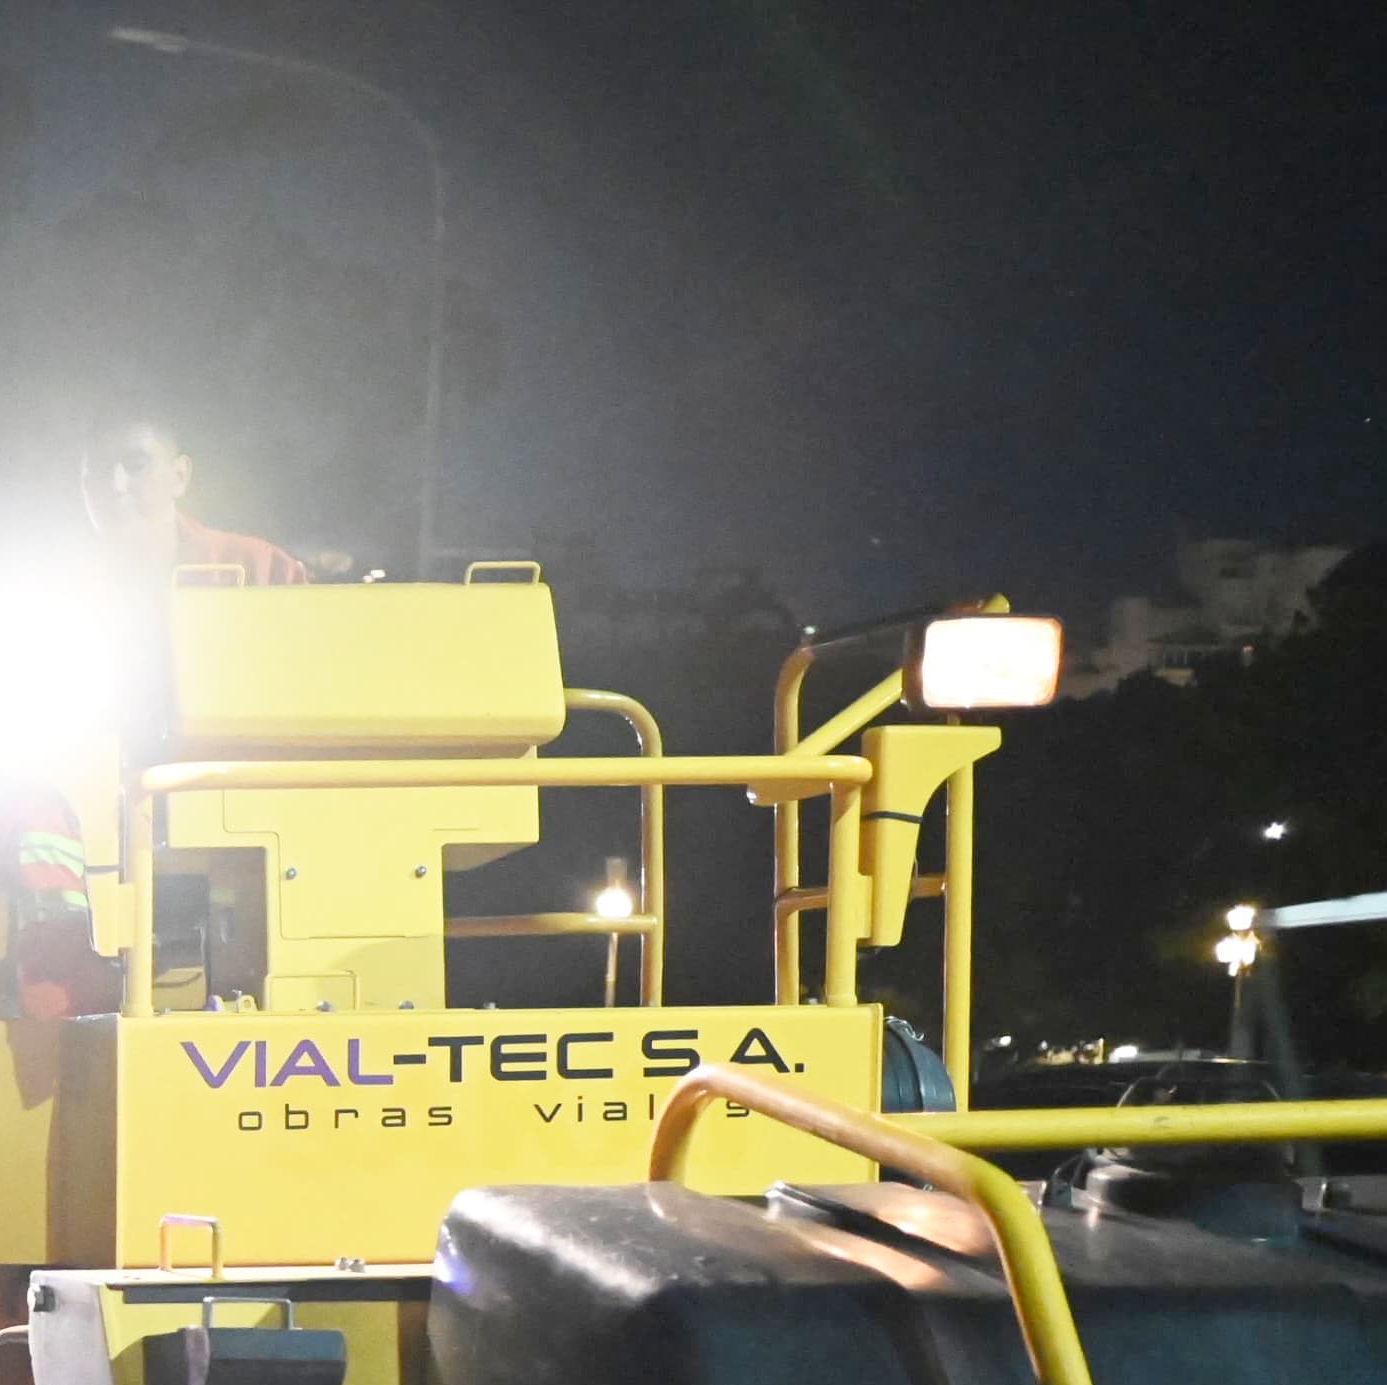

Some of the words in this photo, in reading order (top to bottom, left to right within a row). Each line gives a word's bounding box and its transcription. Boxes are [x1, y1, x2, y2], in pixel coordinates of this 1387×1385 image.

[179, 1031, 614, 1089] VIAL-TEC
[238, 1103, 453, 1131] obras
[533, 1093, 751, 1123] vials
